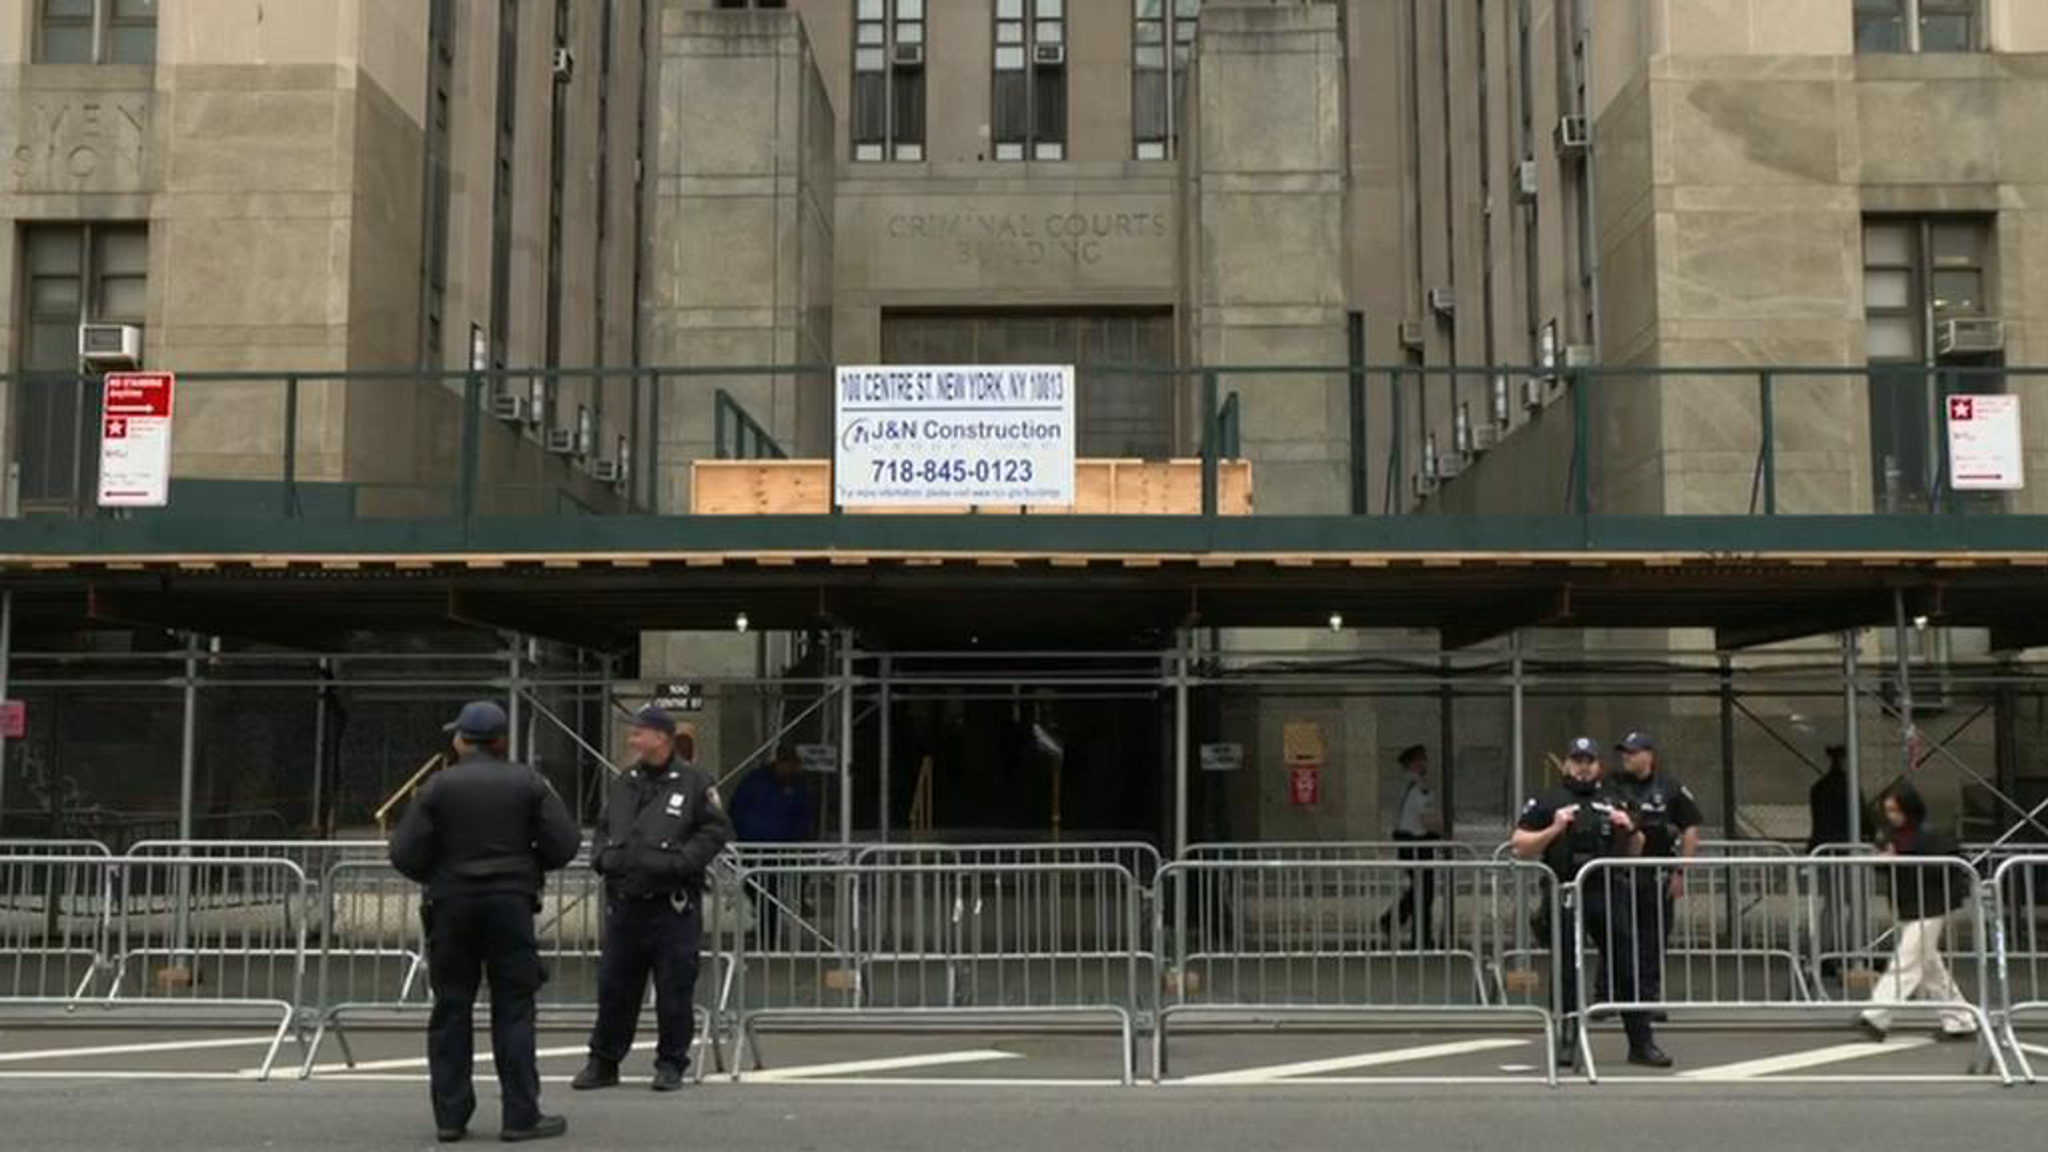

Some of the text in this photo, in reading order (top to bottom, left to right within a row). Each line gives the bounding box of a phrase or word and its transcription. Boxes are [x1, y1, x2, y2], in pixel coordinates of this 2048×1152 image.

[1044, 212, 1169, 239] COURTS
[864, 371, 915, 401] CENTRE
[937, 371, 966, 401] NEW
[1008, 371, 1027, 401] NY
[871, 418, 1062, 440] J&N Construction
[871, 458, 1034, 483] 718-845-0123
